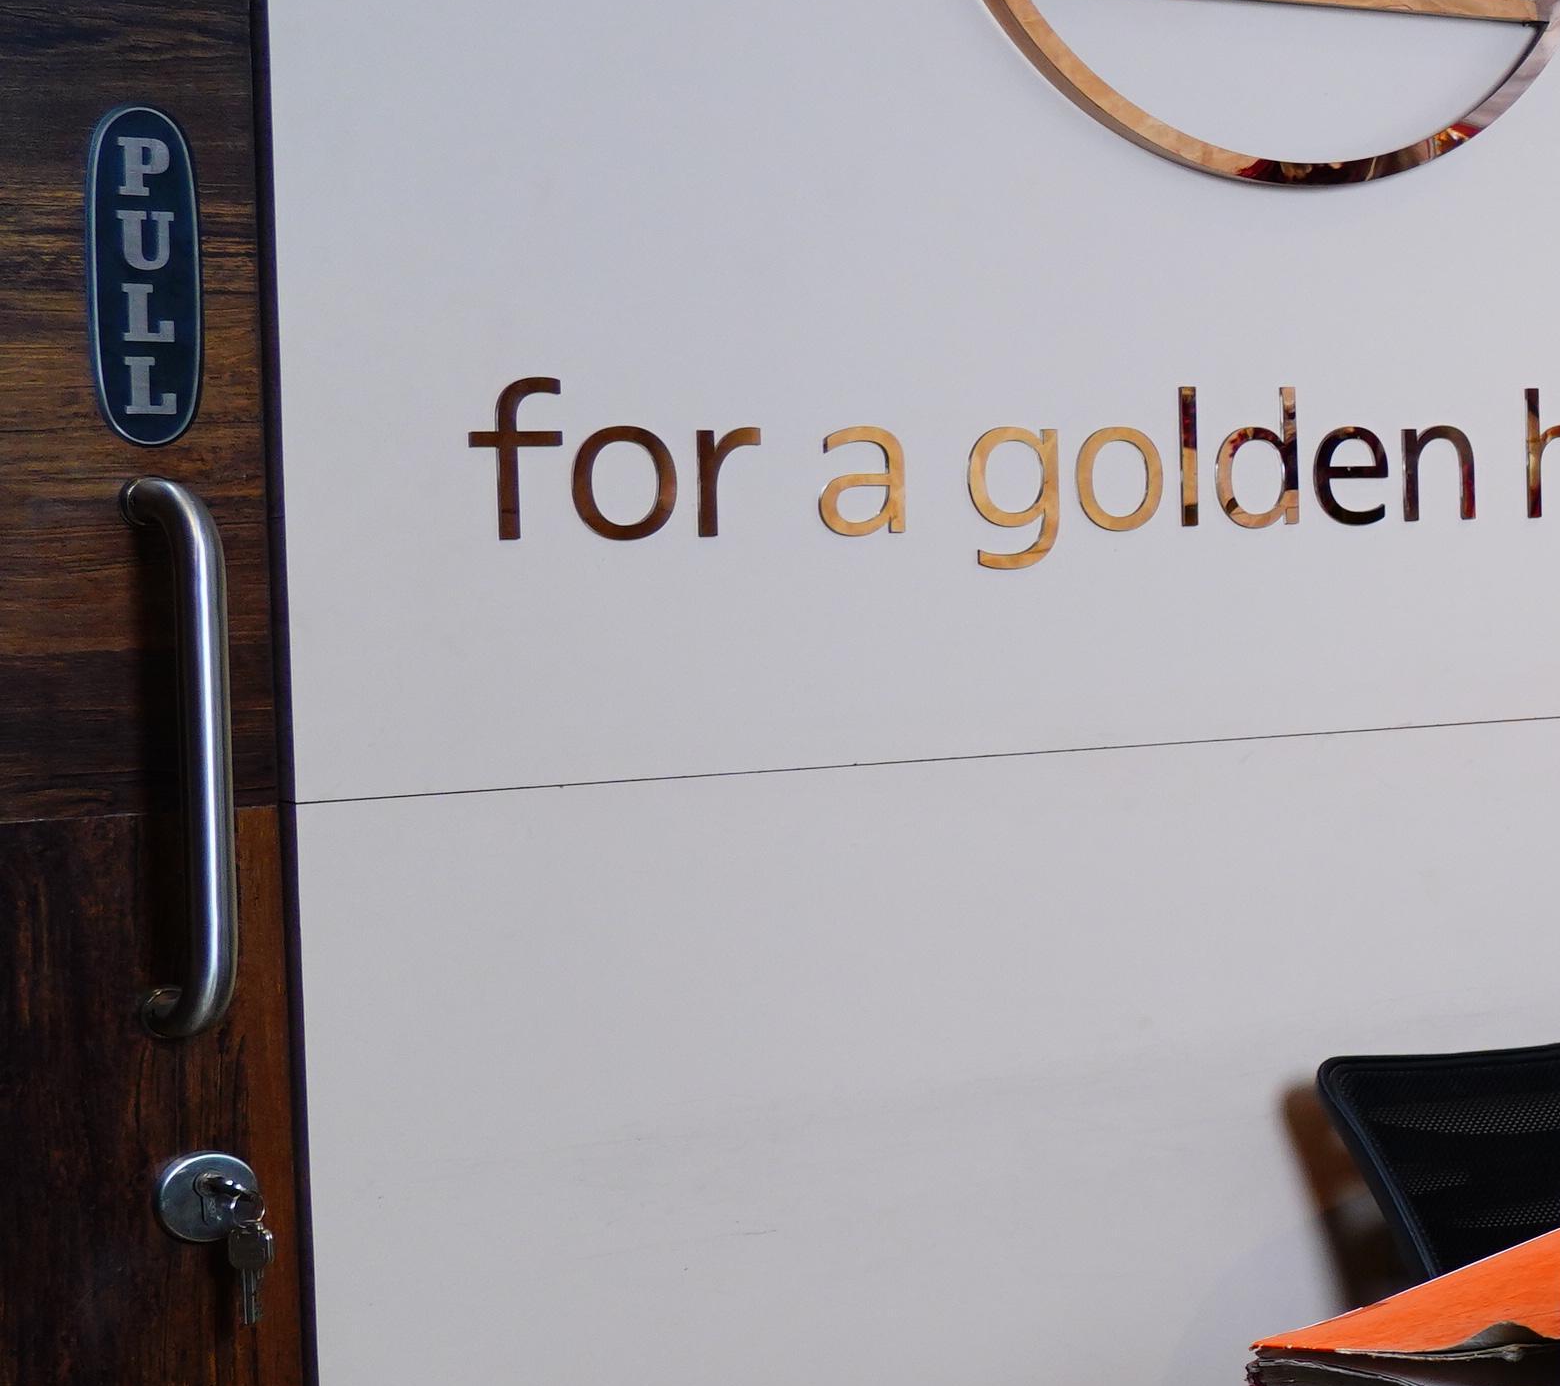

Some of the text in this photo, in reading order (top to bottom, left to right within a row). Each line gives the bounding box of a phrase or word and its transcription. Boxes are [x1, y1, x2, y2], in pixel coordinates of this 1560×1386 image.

[116, 136, 178, 416] PULL
[468, 376, 762, 542] for
[818, 425, 906, 538] a
[967, 386, 1477, 570] golden
